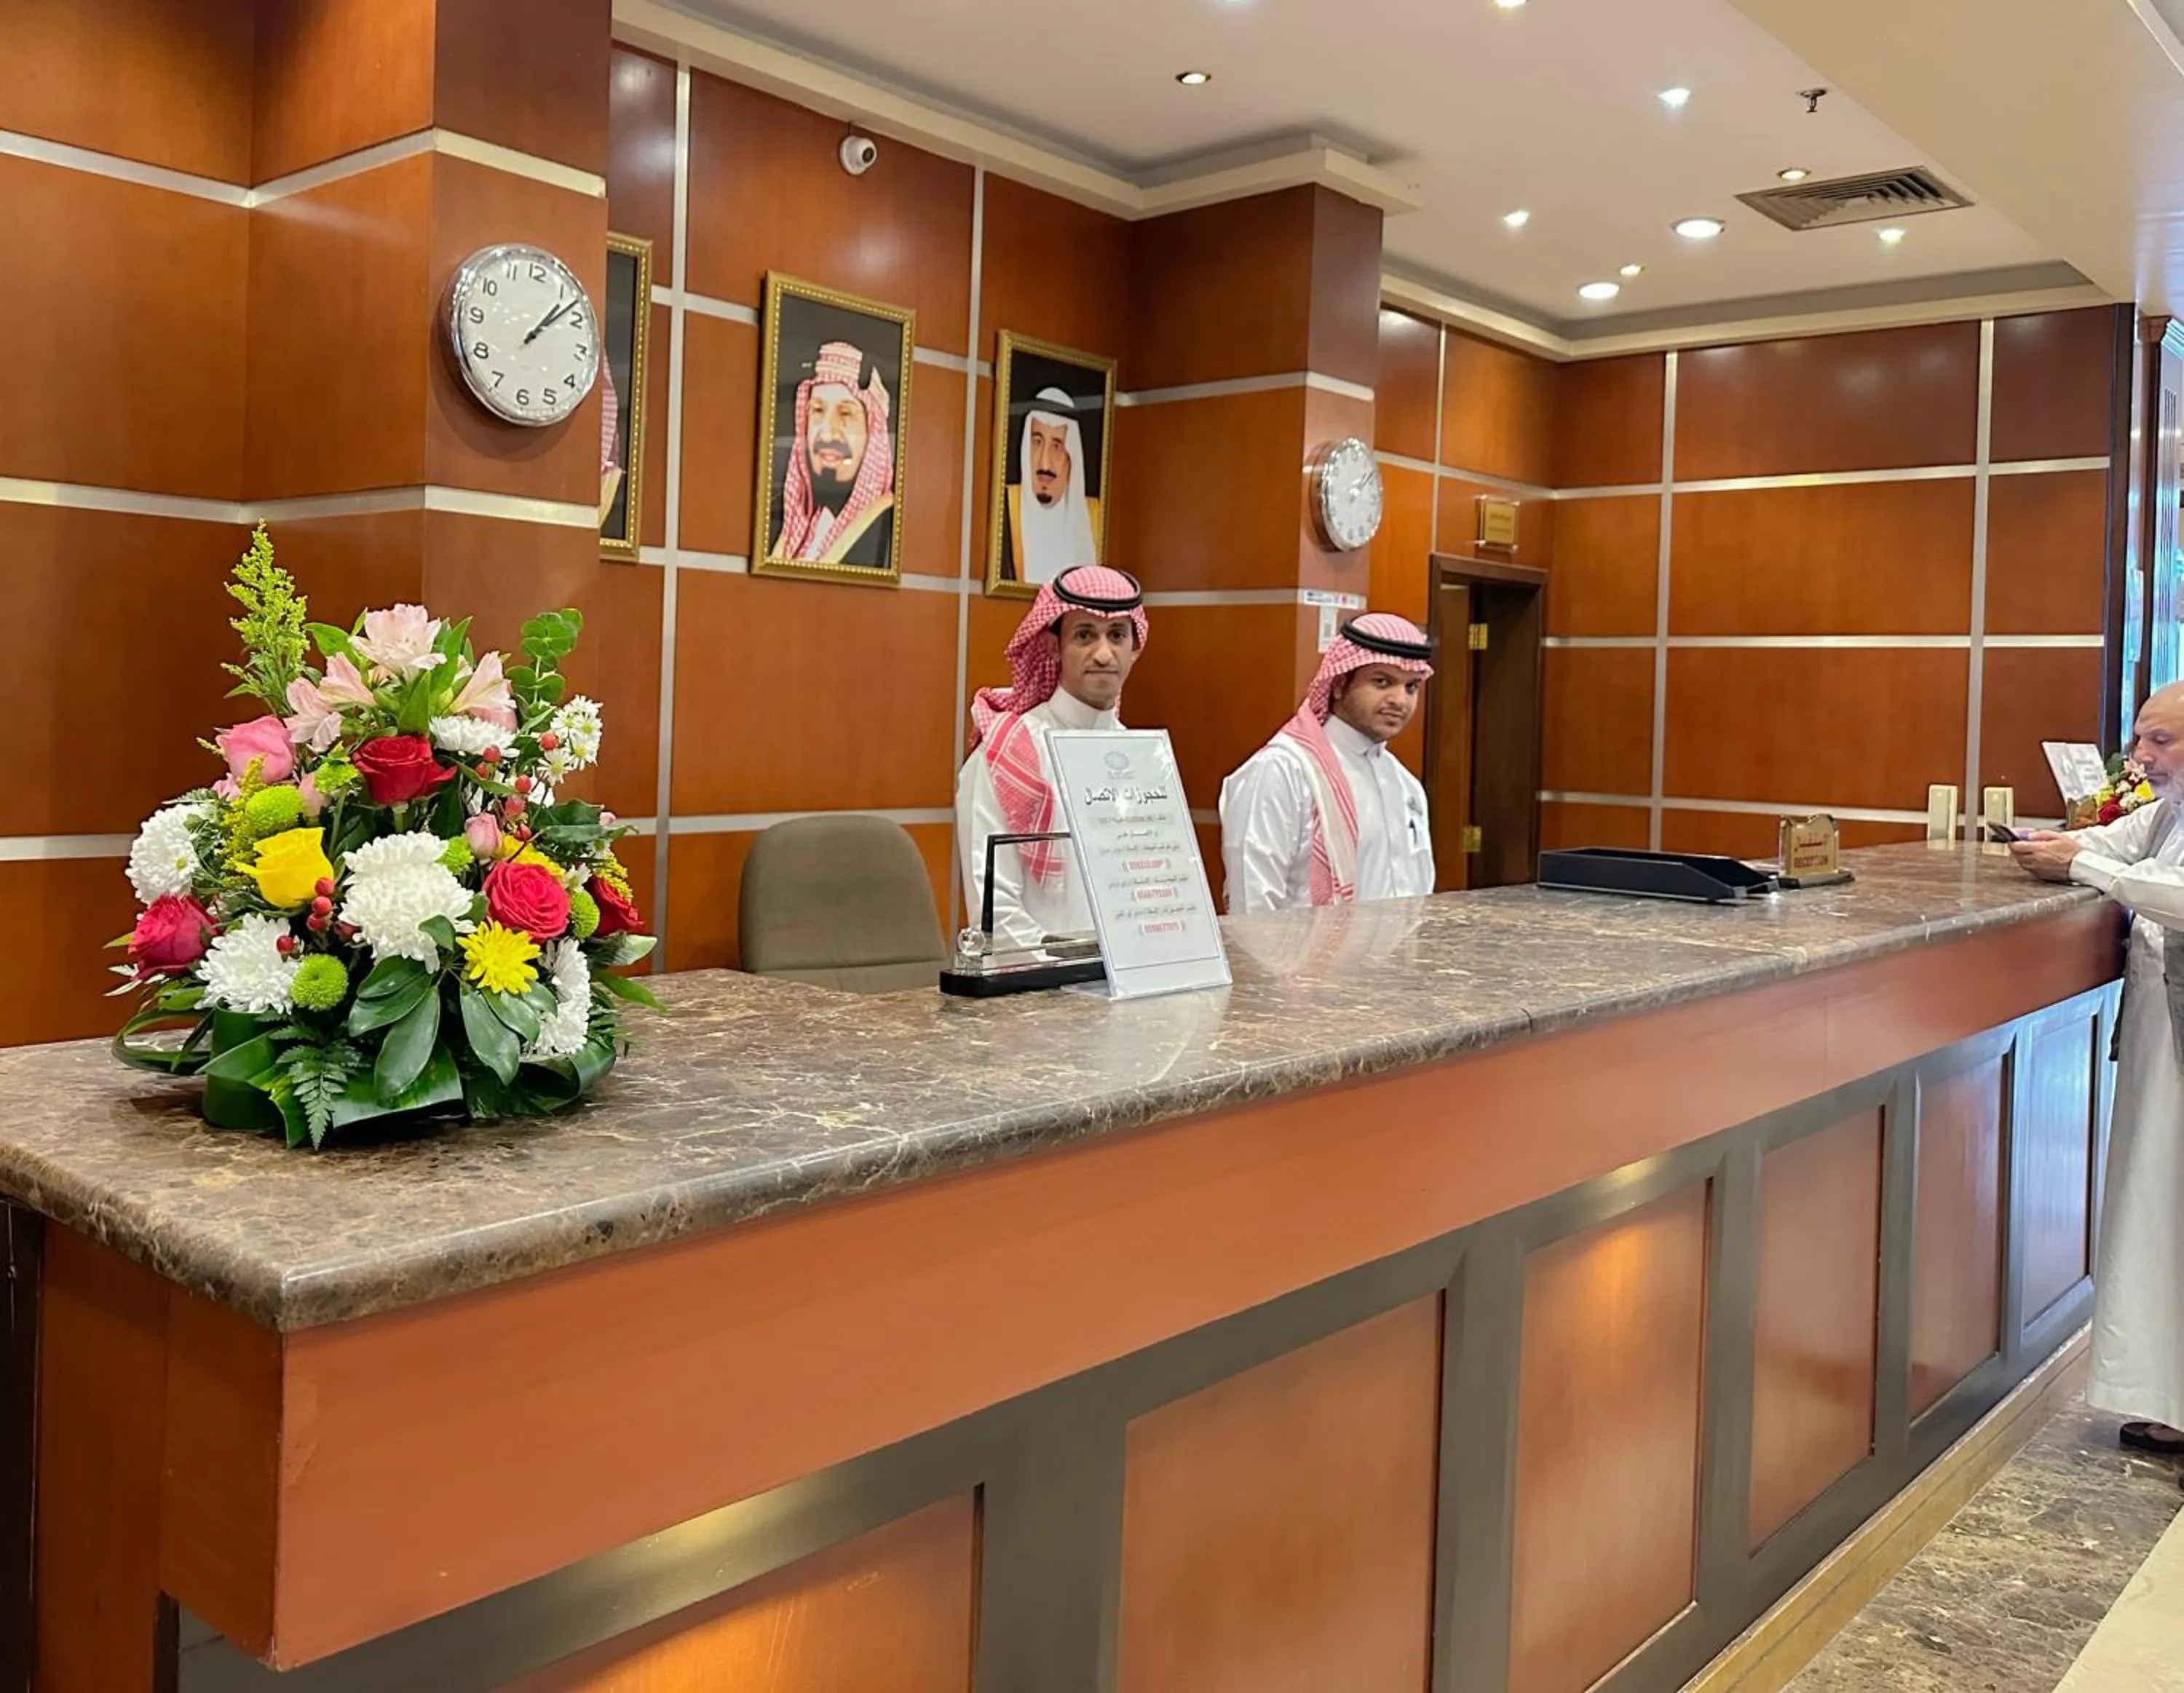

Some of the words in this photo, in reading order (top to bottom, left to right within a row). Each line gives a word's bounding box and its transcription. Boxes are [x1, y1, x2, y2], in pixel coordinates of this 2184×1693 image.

[507, 263, 518, 280] 11
[529, 263, 547, 283] 12
[482, 277, 497, 296] 10
[560, 283, 564, 299] 1
[469, 306, 484, 324] 9
[570, 311, 583, 329] 2
[473, 341, 489, 359] 8
[573, 343, 587, 362] 3
[491, 370, 505, 388] 7
[563, 373, 576, 389] 4
[515, 389, 529, 405] 6
[542, 388, 558, 405] 5
